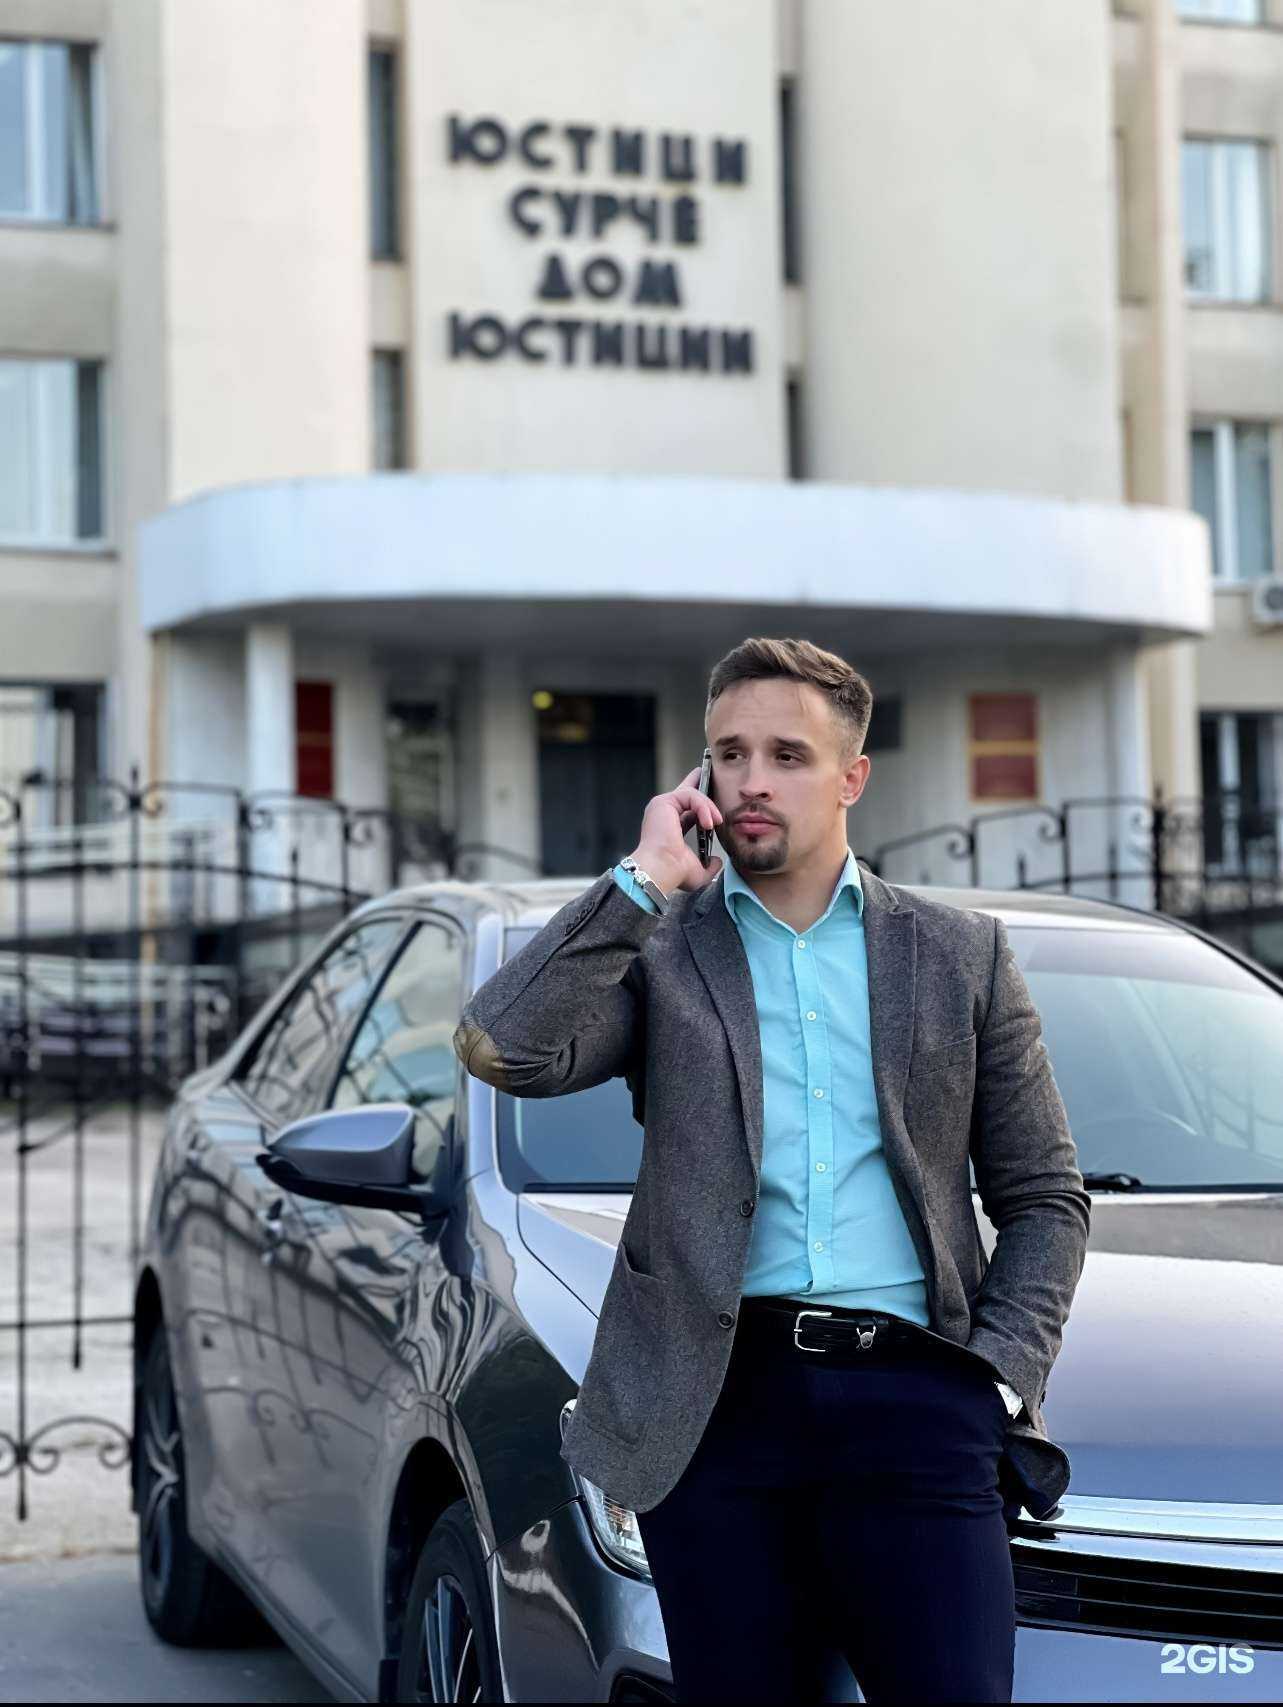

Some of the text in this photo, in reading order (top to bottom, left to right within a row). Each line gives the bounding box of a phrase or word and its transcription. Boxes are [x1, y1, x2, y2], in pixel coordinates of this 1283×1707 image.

[446, 116, 747, 188] ЮСТИЦИ
[536, 254, 683, 309] ДОМ
[448, 313, 755, 376] ЮСТИЦИИ
